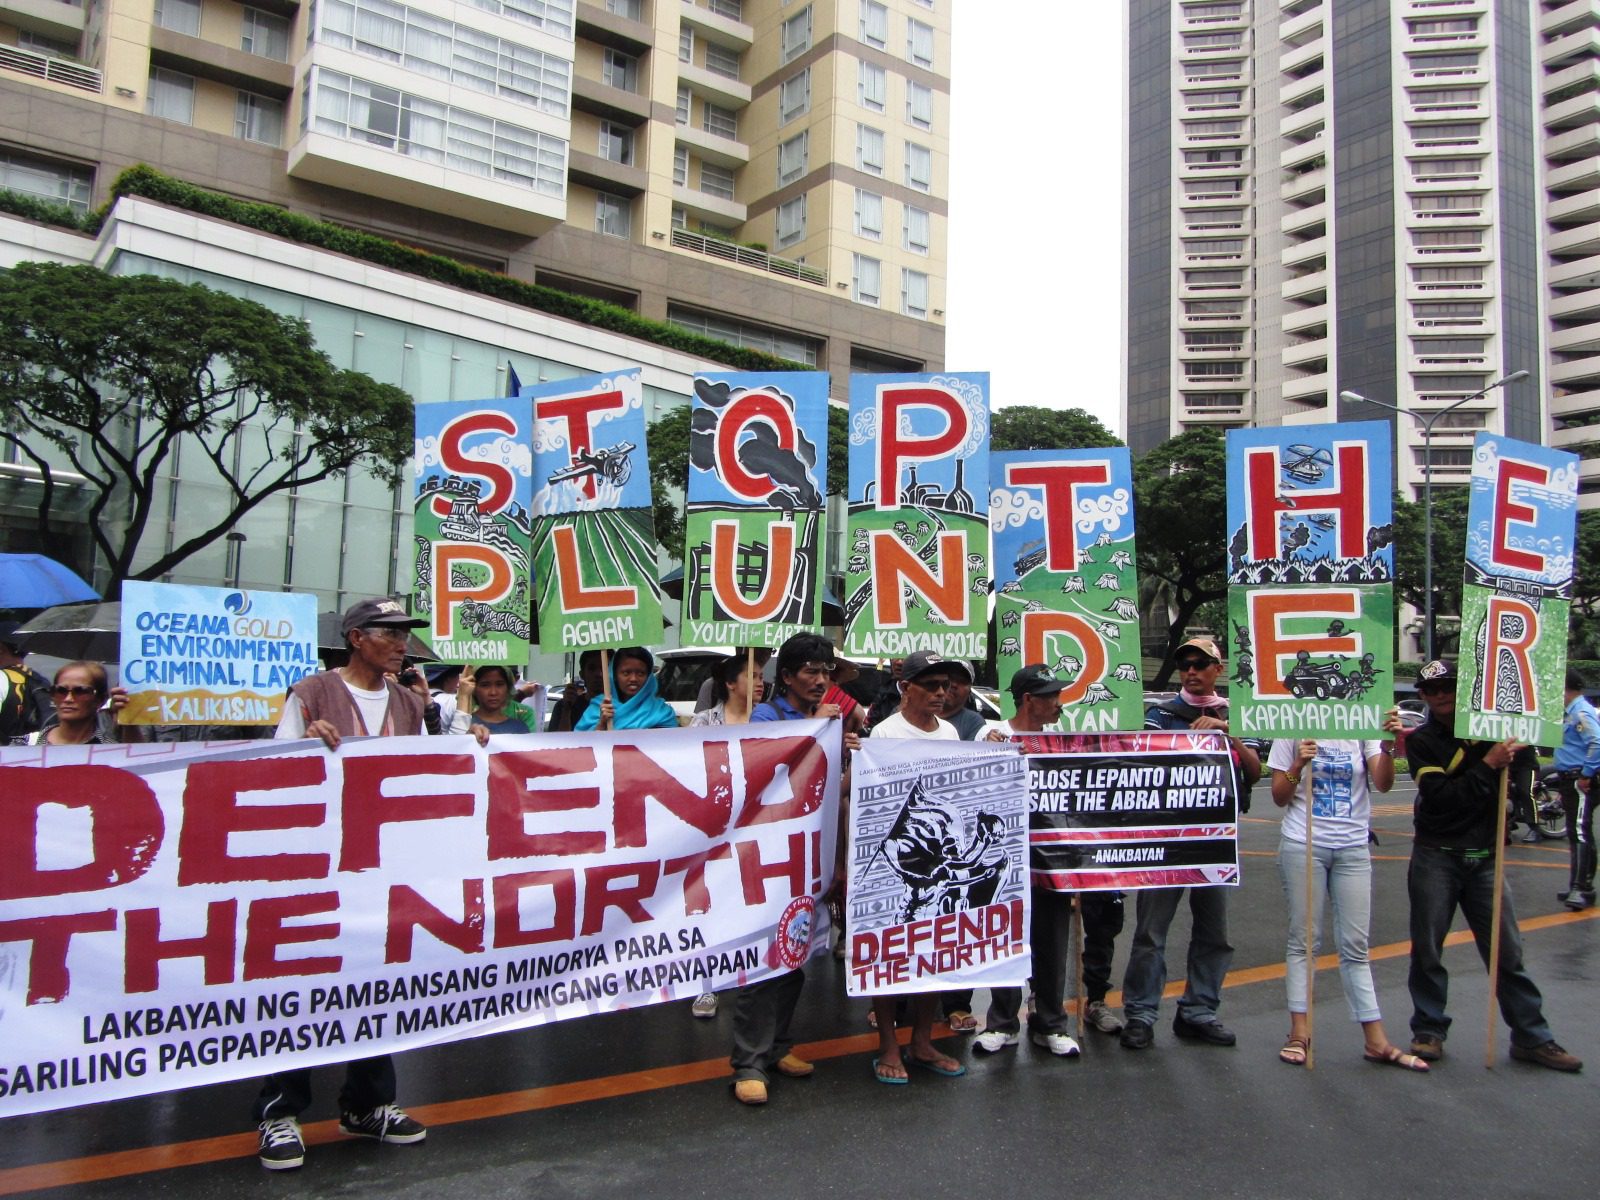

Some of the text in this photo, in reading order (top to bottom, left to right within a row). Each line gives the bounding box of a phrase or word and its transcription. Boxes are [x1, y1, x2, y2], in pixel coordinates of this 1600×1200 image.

[432, 411, 517, 517] S
[536, 391, 624, 501] T
[877, 385, 970, 510] P
[1006, 460, 1111, 573] T
[1244, 440, 1368, 562] H
[1492, 456, 1552, 573] E
[432, 542, 515, 640] P
[553, 526, 638, 613] L
[711, 521, 796, 623] U
[870, 531, 969, 628] N
[125, 659, 247, 688] CRIMINAL,
[136, 611, 293, 639] OCEANA GOLD
[141, 634, 317, 665] ENVIRONMENTAL
[433, 640, 508, 661] KALIKASAN
[562, 617, 634, 646] AGHAM
[691, 622, 748, 644] YOUTH
[1247, 588, 1361, 699] E
[1482, 595, 1541, 717] R
[1240, 703, 1381, 732] KAPAYAPAAN
[1469, 713, 1541, 744] KATRIBU
[0, 735, 829, 901] DEFEND
[1029, 765, 1221, 790] CLOSE LEPANTO NOW!
[1029, 787, 1226, 812] SAVE THE ABRA RIVER!
[0, 830, 822, 1007] THE NORTH!
[82, 926, 707, 1045] LAKBAYAN NG PAMBANSANG MINORYA PARA SA
[851, 954, 911, 992] THE
[0, 946, 760, 1099] SARILING PAGPAPASYA AT MAKATARUNGANG KAPAYAPAAN
